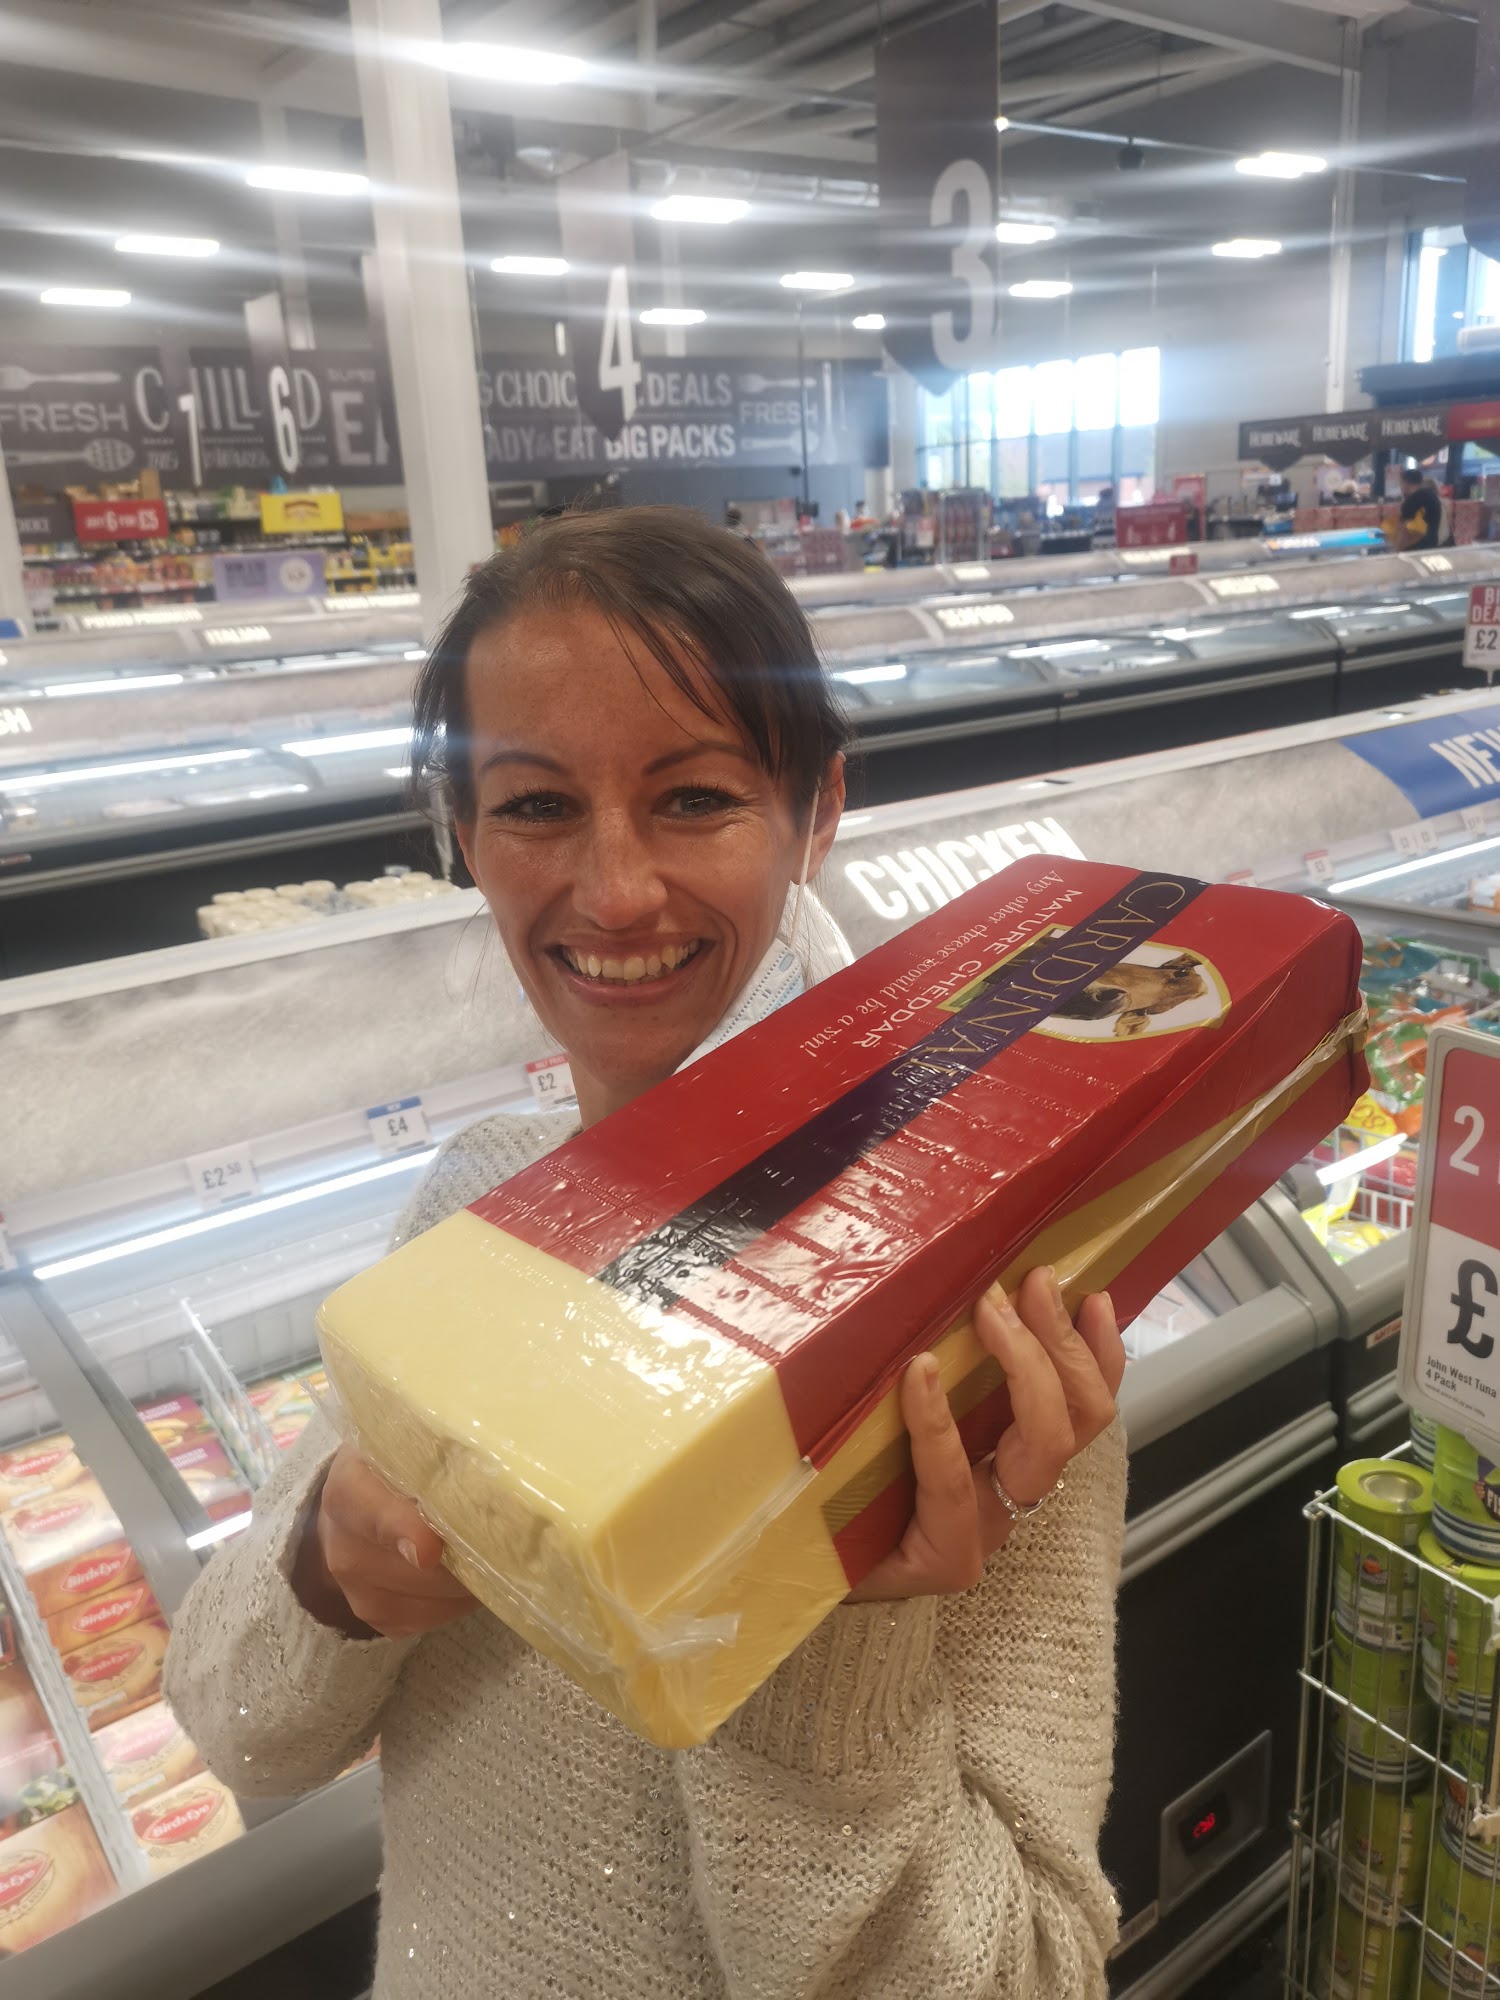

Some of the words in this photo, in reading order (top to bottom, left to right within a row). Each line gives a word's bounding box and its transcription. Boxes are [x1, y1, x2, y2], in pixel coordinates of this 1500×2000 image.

[930, 159, 997, 370] 3
[598, 266, 642, 421] 4
[0, 402, 129, 432] FRESH
[269, 365, 298, 474] 6
[738, 402, 819, 426] FRESH
[1381, 415, 1443, 438] HOMEWARE
[178, 394, 202, 487] 1
[553, 424, 597, 461] EAT
[651, 422, 737, 458] PACKS
[1312, 421, 1369, 443] HOMEWARE
[1474, 628, 1498, 651] £2
[844, 816, 1088, 920] CHICKEN
[1026, 869, 1065, 895] Any
[983, 889, 1083, 955] MATURE
[988, 895, 1029, 925] other
[940, 922, 989, 960] cheese
[879, 957, 942, 1002] would
[892, 881, 1186, 1078] CARDINAL
[836, 1015, 855, 1028] a
[852, 959, 982, 1049] CHEDDAR
[857, 997, 888, 1015] be
[799, 1025, 843, 1058] sin!
[537, 1072, 558, 1092] £2
[388, 1116, 409, 1137] £4
[1450, 1105, 1485, 1176] 2
[1426, 1368, 1432, 1379] 4
[1434, 1371, 1457, 1391] Pack
[1427, 1355, 1448, 1373] John
[1450, 1365, 1473, 1386] West
[1474, 1378, 1497, 1399] Tuna
